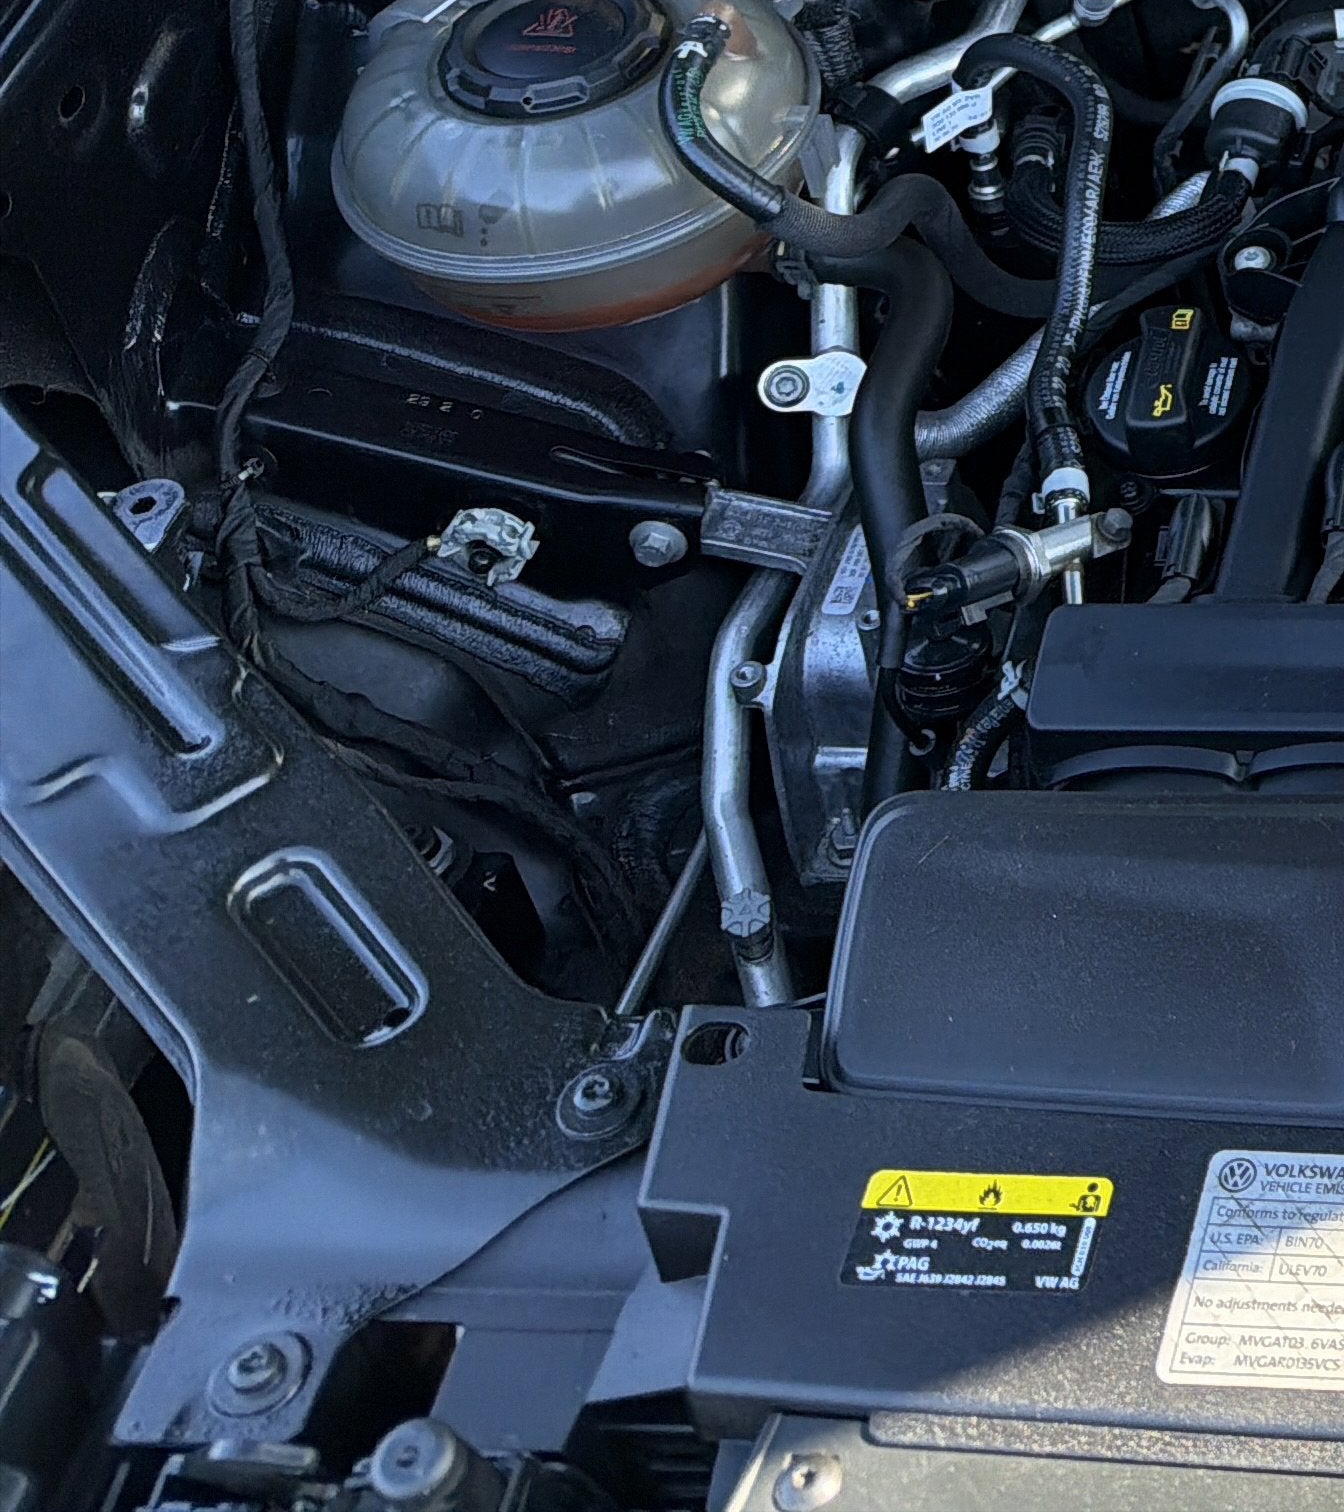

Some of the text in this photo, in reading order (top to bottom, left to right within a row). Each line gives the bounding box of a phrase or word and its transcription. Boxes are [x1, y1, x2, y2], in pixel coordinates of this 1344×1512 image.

[1261, 1180, 1315, 1195] VEHICLE
[1217, 1205, 1278, 1220] Conforms
[1282, 1208, 1297, 1220] to
[909, 1215, 1067, 1238] R-1234yf 0.650 kg
[903, 1239, 930, 1249] GWP
[1285, 1235, 1323, 1249] BIN70
[898, 1256, 931, 1272] PAG
[1203, 1259, 1263, 1274] California:
[1279, 1263, 1327, 1277] ULEV70
[1035, 1275, 1080, 1290] VW AG
[1194, 1296, 1213, 1308] No
[1216, 1296, 1298, 1313] adjustments
[1185, 1332, 1231, 1348] Group:
[1180, 1352, 1216, 1367] Evap:
